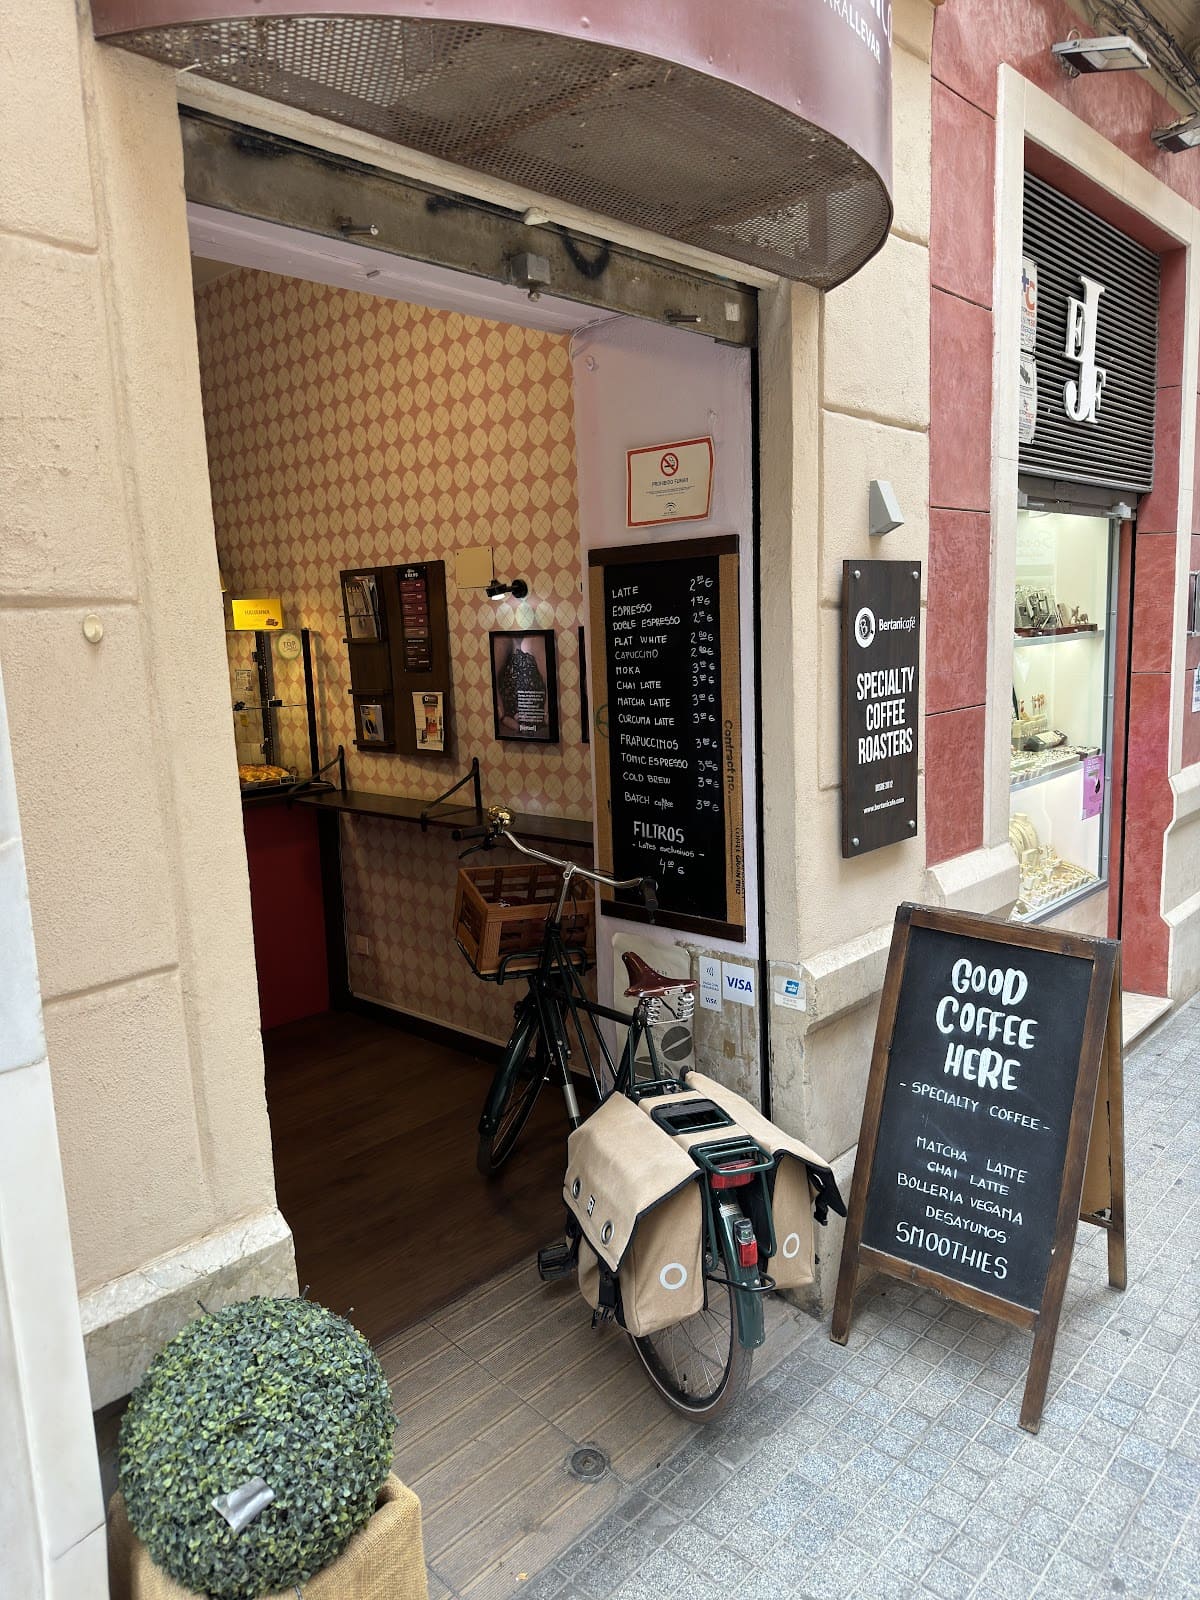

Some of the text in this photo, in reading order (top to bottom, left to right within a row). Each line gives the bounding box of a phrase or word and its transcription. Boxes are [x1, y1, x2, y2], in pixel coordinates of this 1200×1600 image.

[612, 586, 639, 599] LATTE
[612, 603, 652, 617] ESPRESSO
[613, 620, 636, 631] DOBLE
[641, 616, 681, 628] ESPRESSO
[614, 636, 633, 647] FLAT
[640, 635, 668, 644] WHITE
[616, 666, 641, 675] MOKA
[616, 680, 636, 690] CHAI
[640, 681, 662, 689] LATTE
[856, 666, 915, 701] SPECIALTY
[617, 697, 645, 707] MATCHA
[649, 698, 671, 708] LATTE
[618, 714, 650, 725] CURCUMA
[654, 717, 675, 726] LATTE
[866, 698, 906, 731] COFFEE
[620, 733, 679, 750] FRAPUCCINOS
[724, 719, 736, 776] Contract
[858, 727, 913, 765] ROASTERS
[648, 756, 688, 769] ESPRESSO
[622, 771, 644, 783] COLD
[647, 774, 671, 785] BREW
[624, 791, 650, 804] BATCH
[633, 820, 685, 844] FILTROS
[726, 976, 753, 992] VISA
[951, 958, 1029, 1006] GOOD
[705, 997, 717, 1005] VISA
[935, 995, 1039, 1050] COFFEE
[943, 1042, 1022, 1091] HERE
[911, 1081, 1041, 1131] SPECIALTY COFFEE
[916, 1135, 1028, 1184] MATCHA LATTE
[927, 1161, 1010, 1196] CHAI LATTE
[897, 1172, 1024, 1226] BOLLERIA VEGANA
[925, 1205, 1008, 1244] DESAYUNOS
[895, 1221, 1009, 1280] SMOOTHIES
